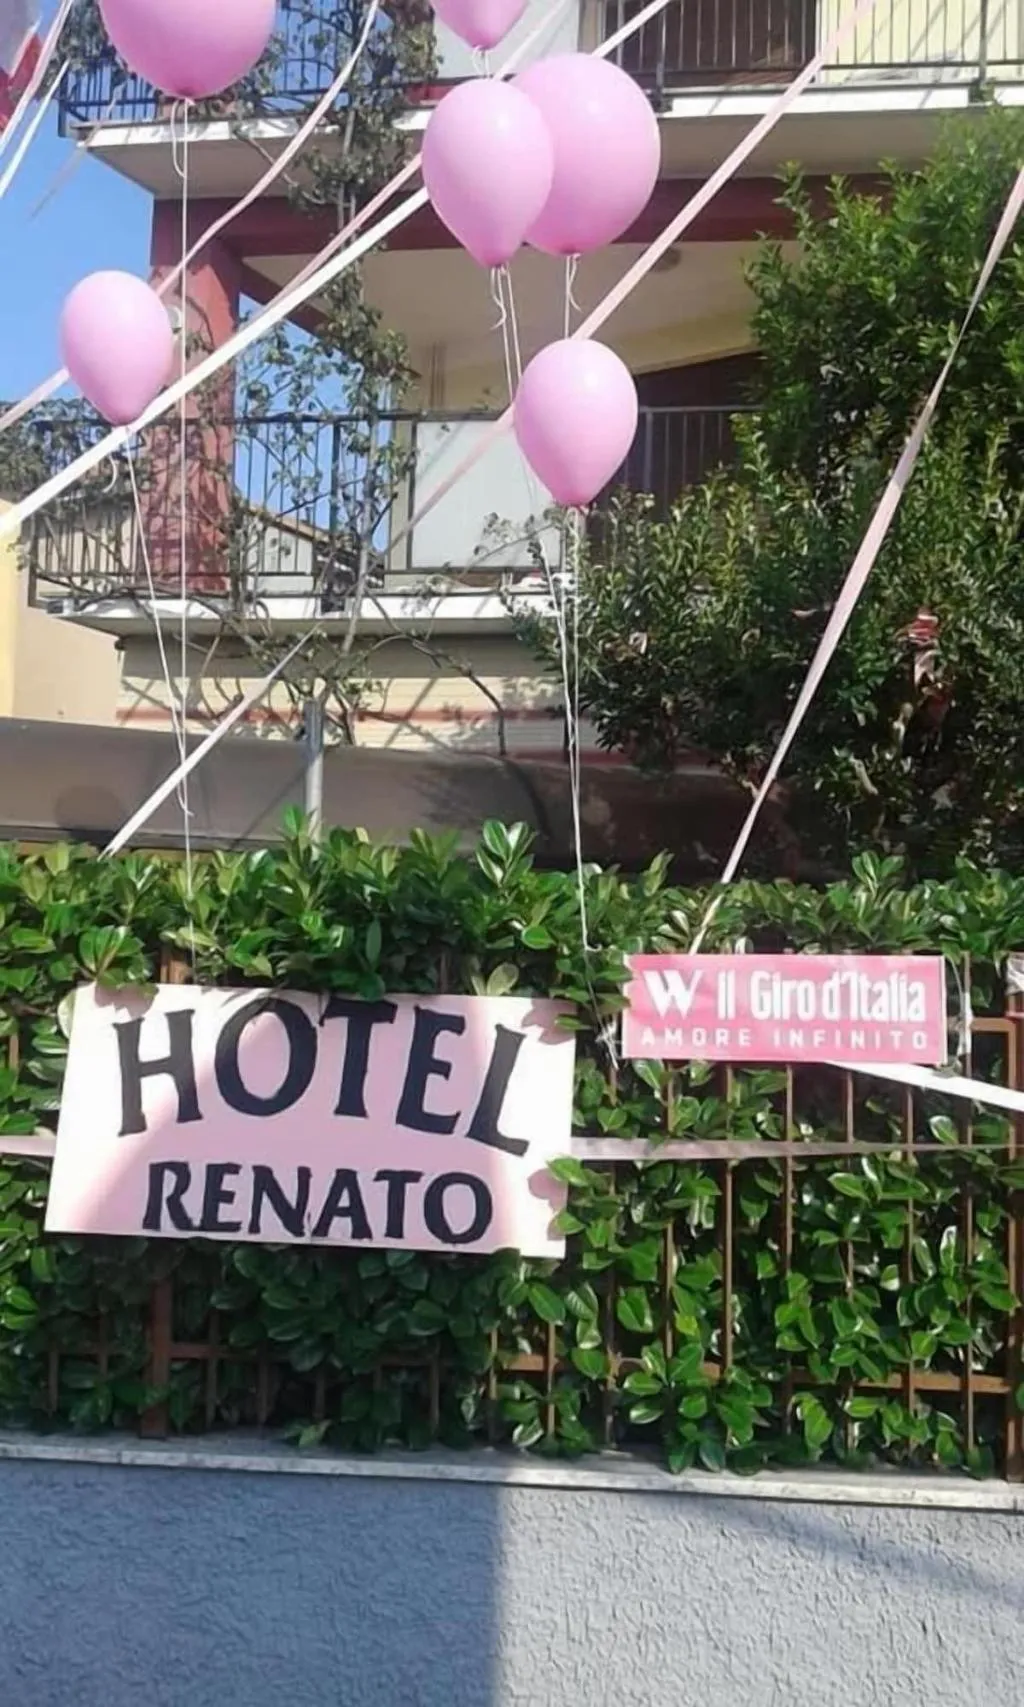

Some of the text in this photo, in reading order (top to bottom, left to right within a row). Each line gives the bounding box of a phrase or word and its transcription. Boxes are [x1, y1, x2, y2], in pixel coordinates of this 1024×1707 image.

[643, 969, 926, 1022] W Il Giro d'Italia
[641, 1028, 928, 1050] AMORE INFINITO
[113, 999, 529, 1157] HOTEL
[142, 1161, 492, 1244] RENATO
